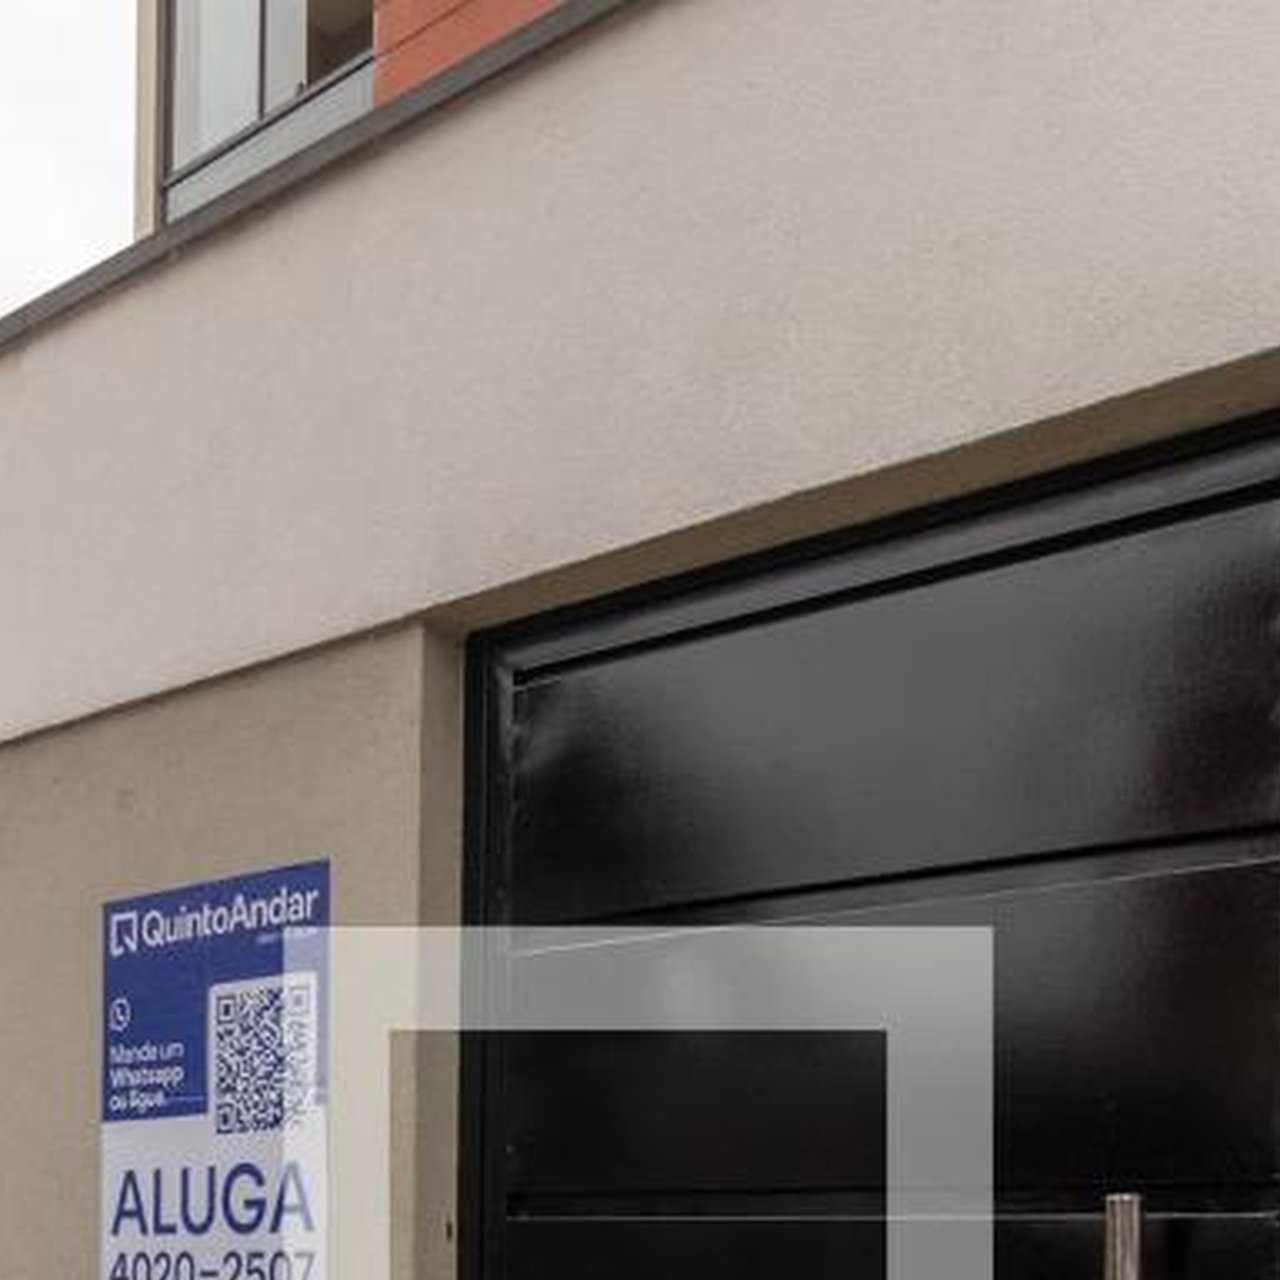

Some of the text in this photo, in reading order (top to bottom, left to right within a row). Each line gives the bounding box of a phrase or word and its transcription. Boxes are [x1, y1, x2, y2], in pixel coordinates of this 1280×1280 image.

[142, 887, 320, 948] QuintoAndar
[160, 1042, 185, 1060] um
[111, 1160, 315, 1236] ALUGA
